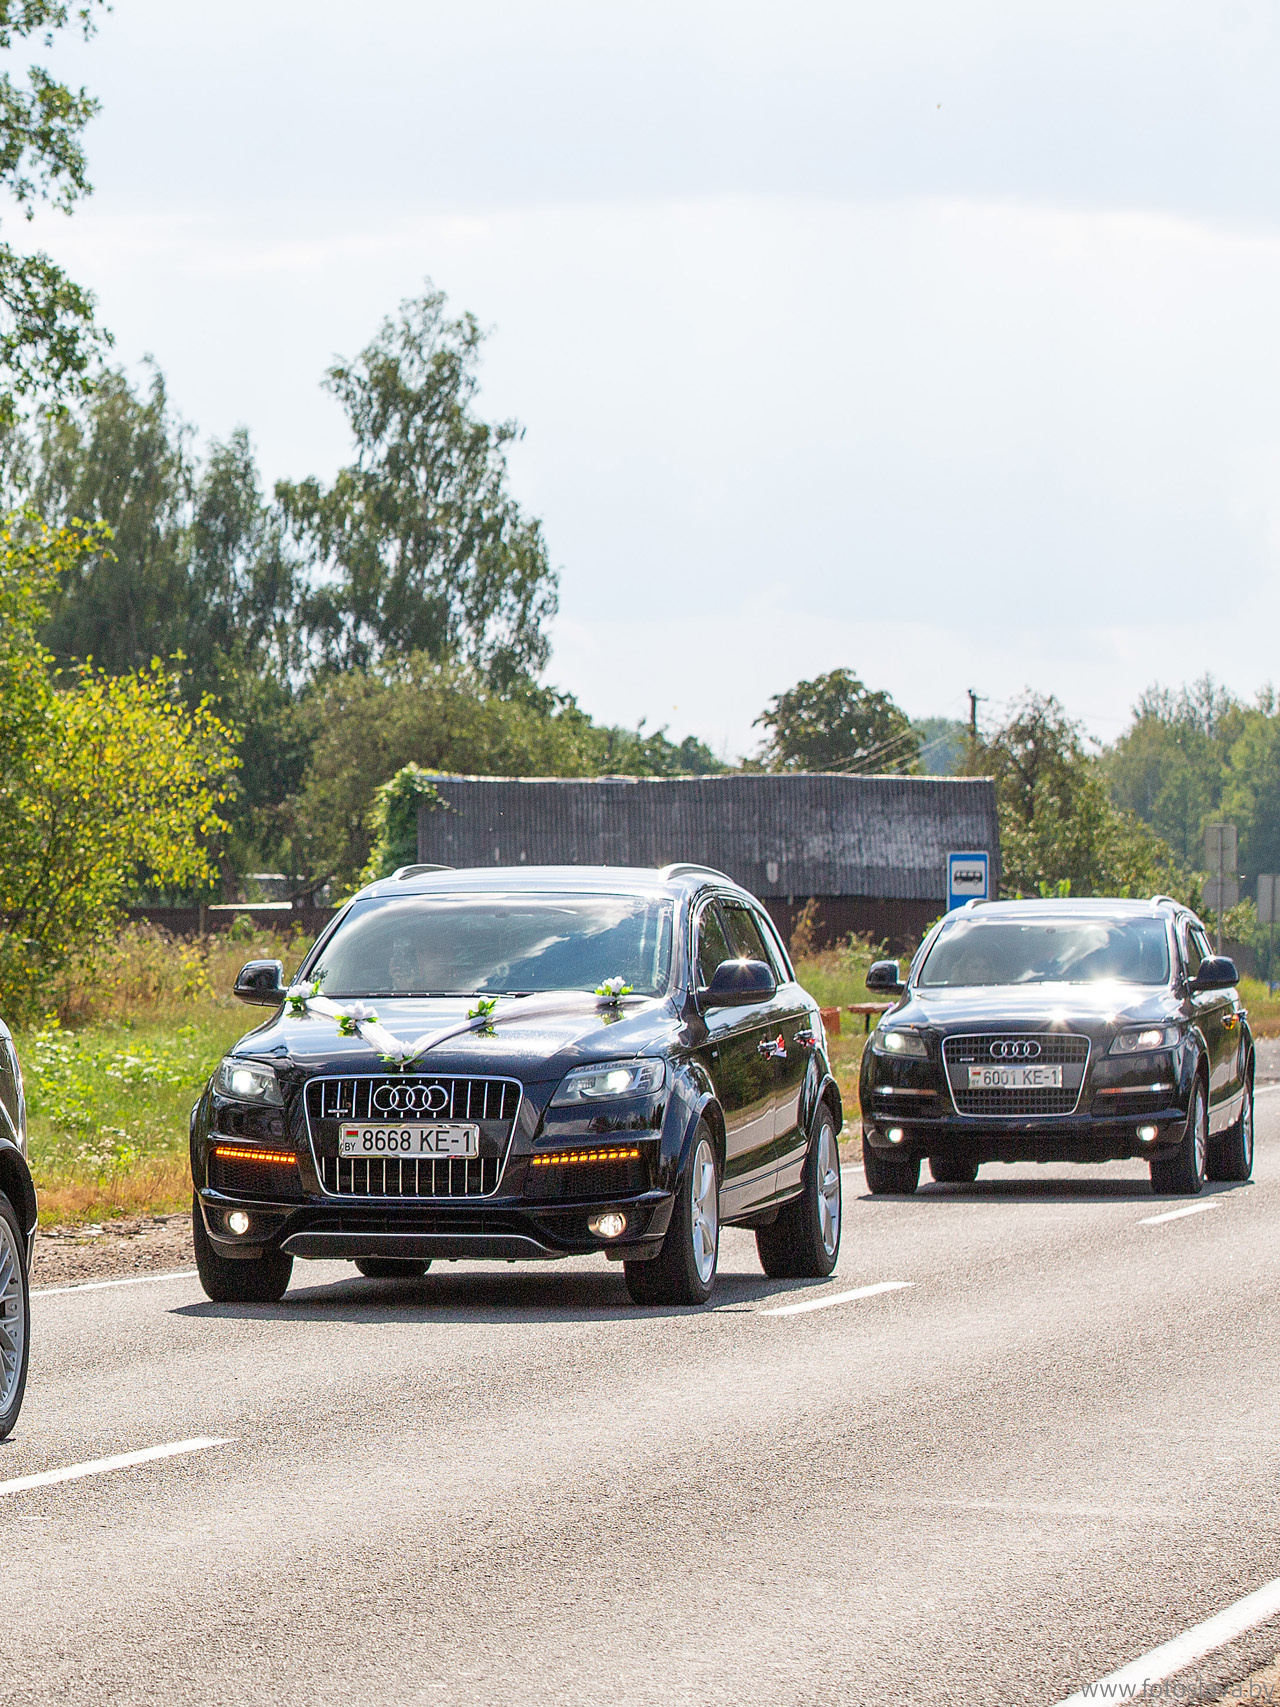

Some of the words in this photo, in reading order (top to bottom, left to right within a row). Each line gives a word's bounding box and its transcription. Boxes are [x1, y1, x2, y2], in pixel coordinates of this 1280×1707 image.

[983, 1071, 1017, 1086] 6001
[1023, 1070, 1058, 1085] KE-1
[344, 1142, 356, 1151] BY
[362, 1130, 412, 1151] 8668
[420, 1130, 471, 1152] KE-1
